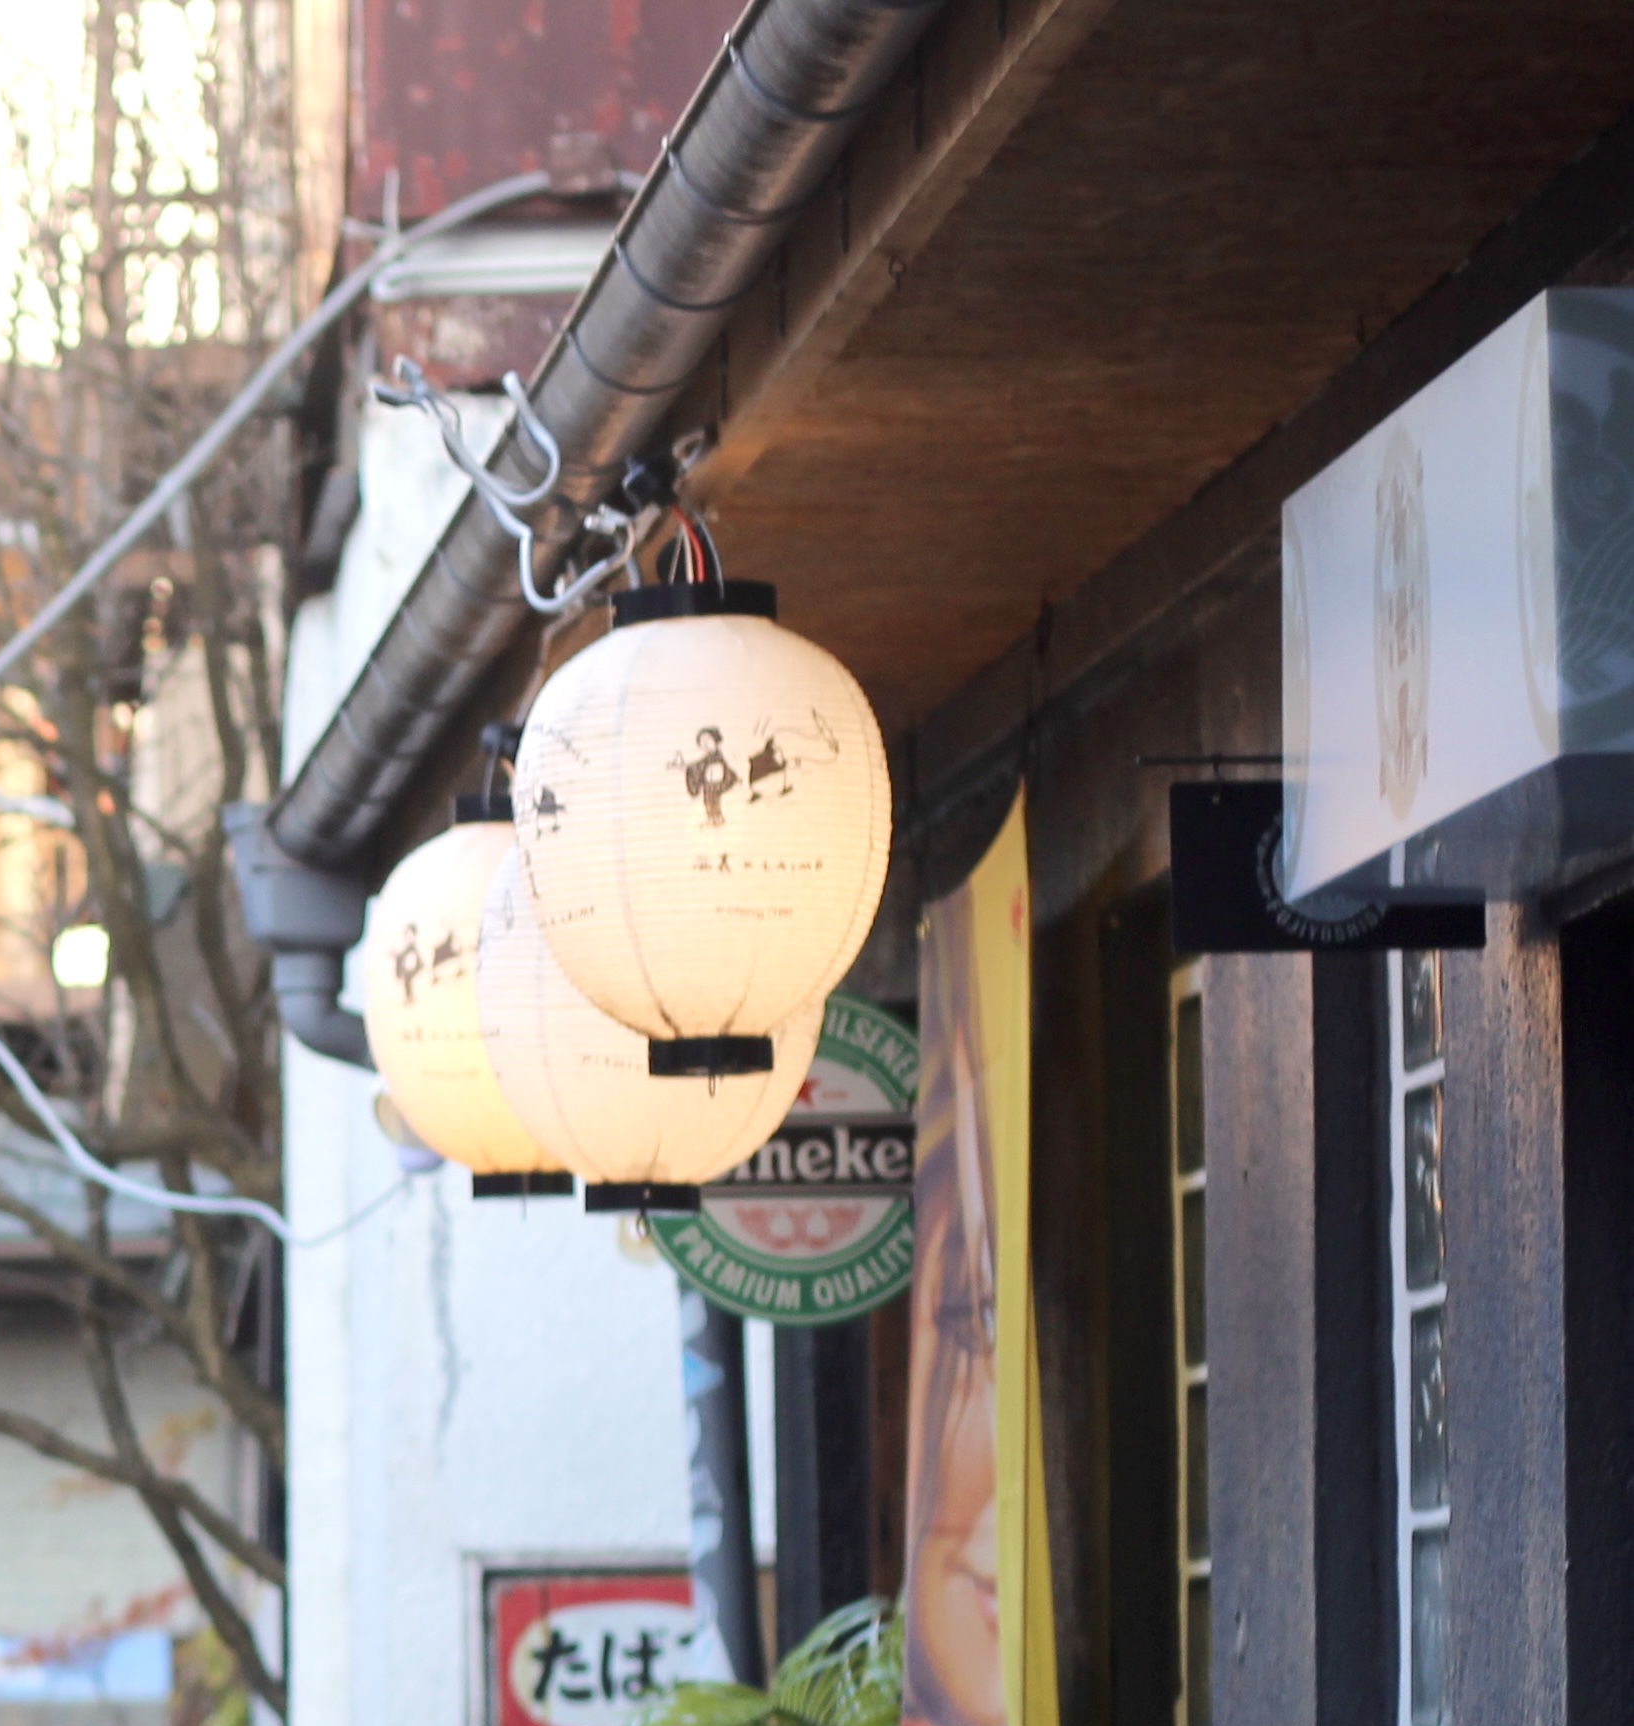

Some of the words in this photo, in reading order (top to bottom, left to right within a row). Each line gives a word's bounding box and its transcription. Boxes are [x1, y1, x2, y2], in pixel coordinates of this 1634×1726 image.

[732, 1127, 910, 1182] neke
[672, 1225, 802, 1311] PREMIUM
[530, 1627, 694, 1702] たば
